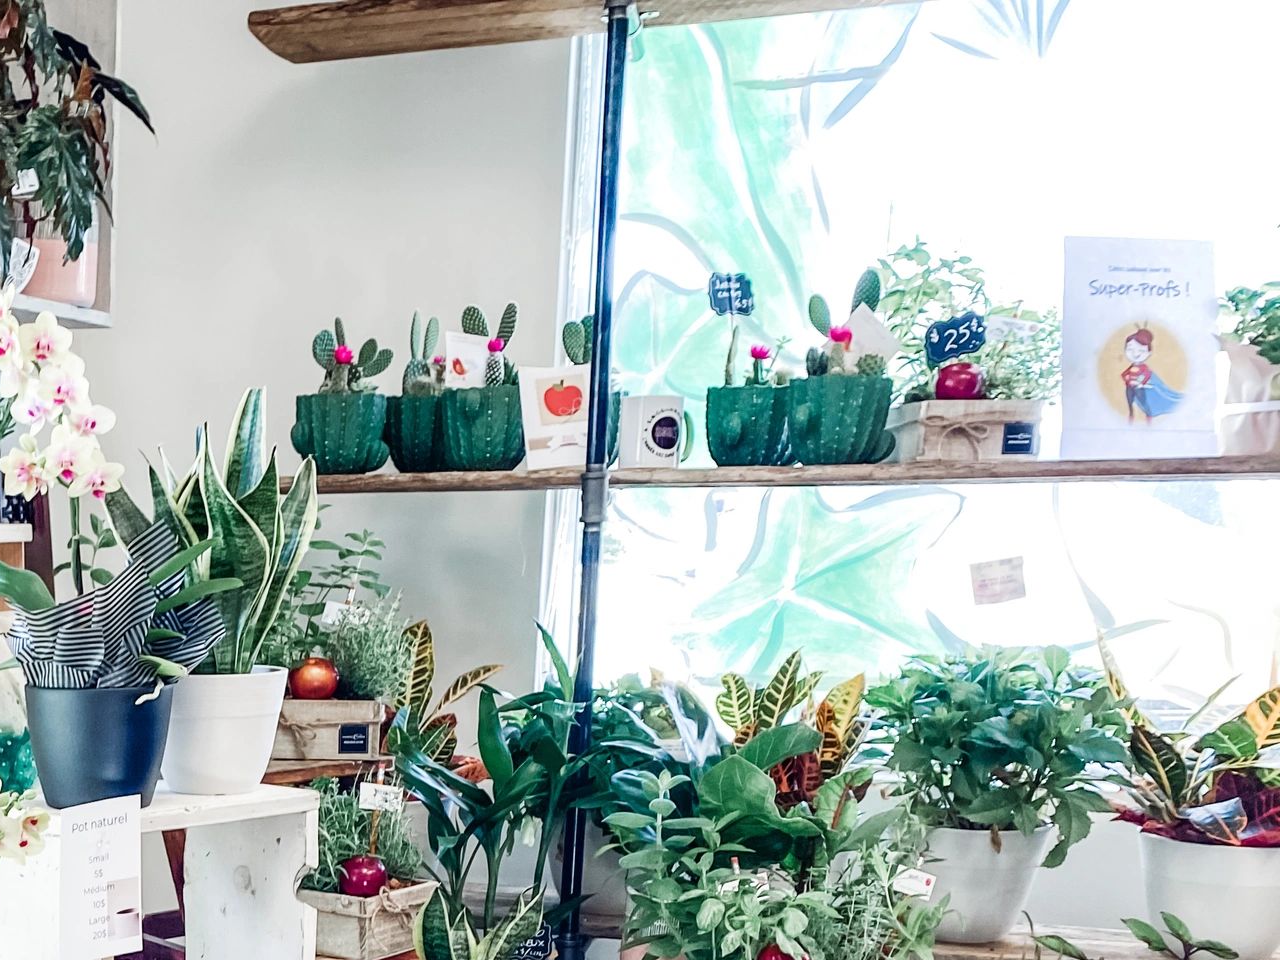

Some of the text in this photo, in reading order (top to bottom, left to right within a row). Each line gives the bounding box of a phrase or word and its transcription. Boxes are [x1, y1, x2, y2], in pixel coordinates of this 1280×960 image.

[1088, 279, 1191, 299] Super-Profs !
[71, 811, 128, 834] Pot naturel
[88, 851, 110, 864] Small
[94, 868, 104, 878] 5$
[92, 898, 106, 909] 10$
[88, 915, 111, 926] Large
[92, 929, 107, 940] 20$
